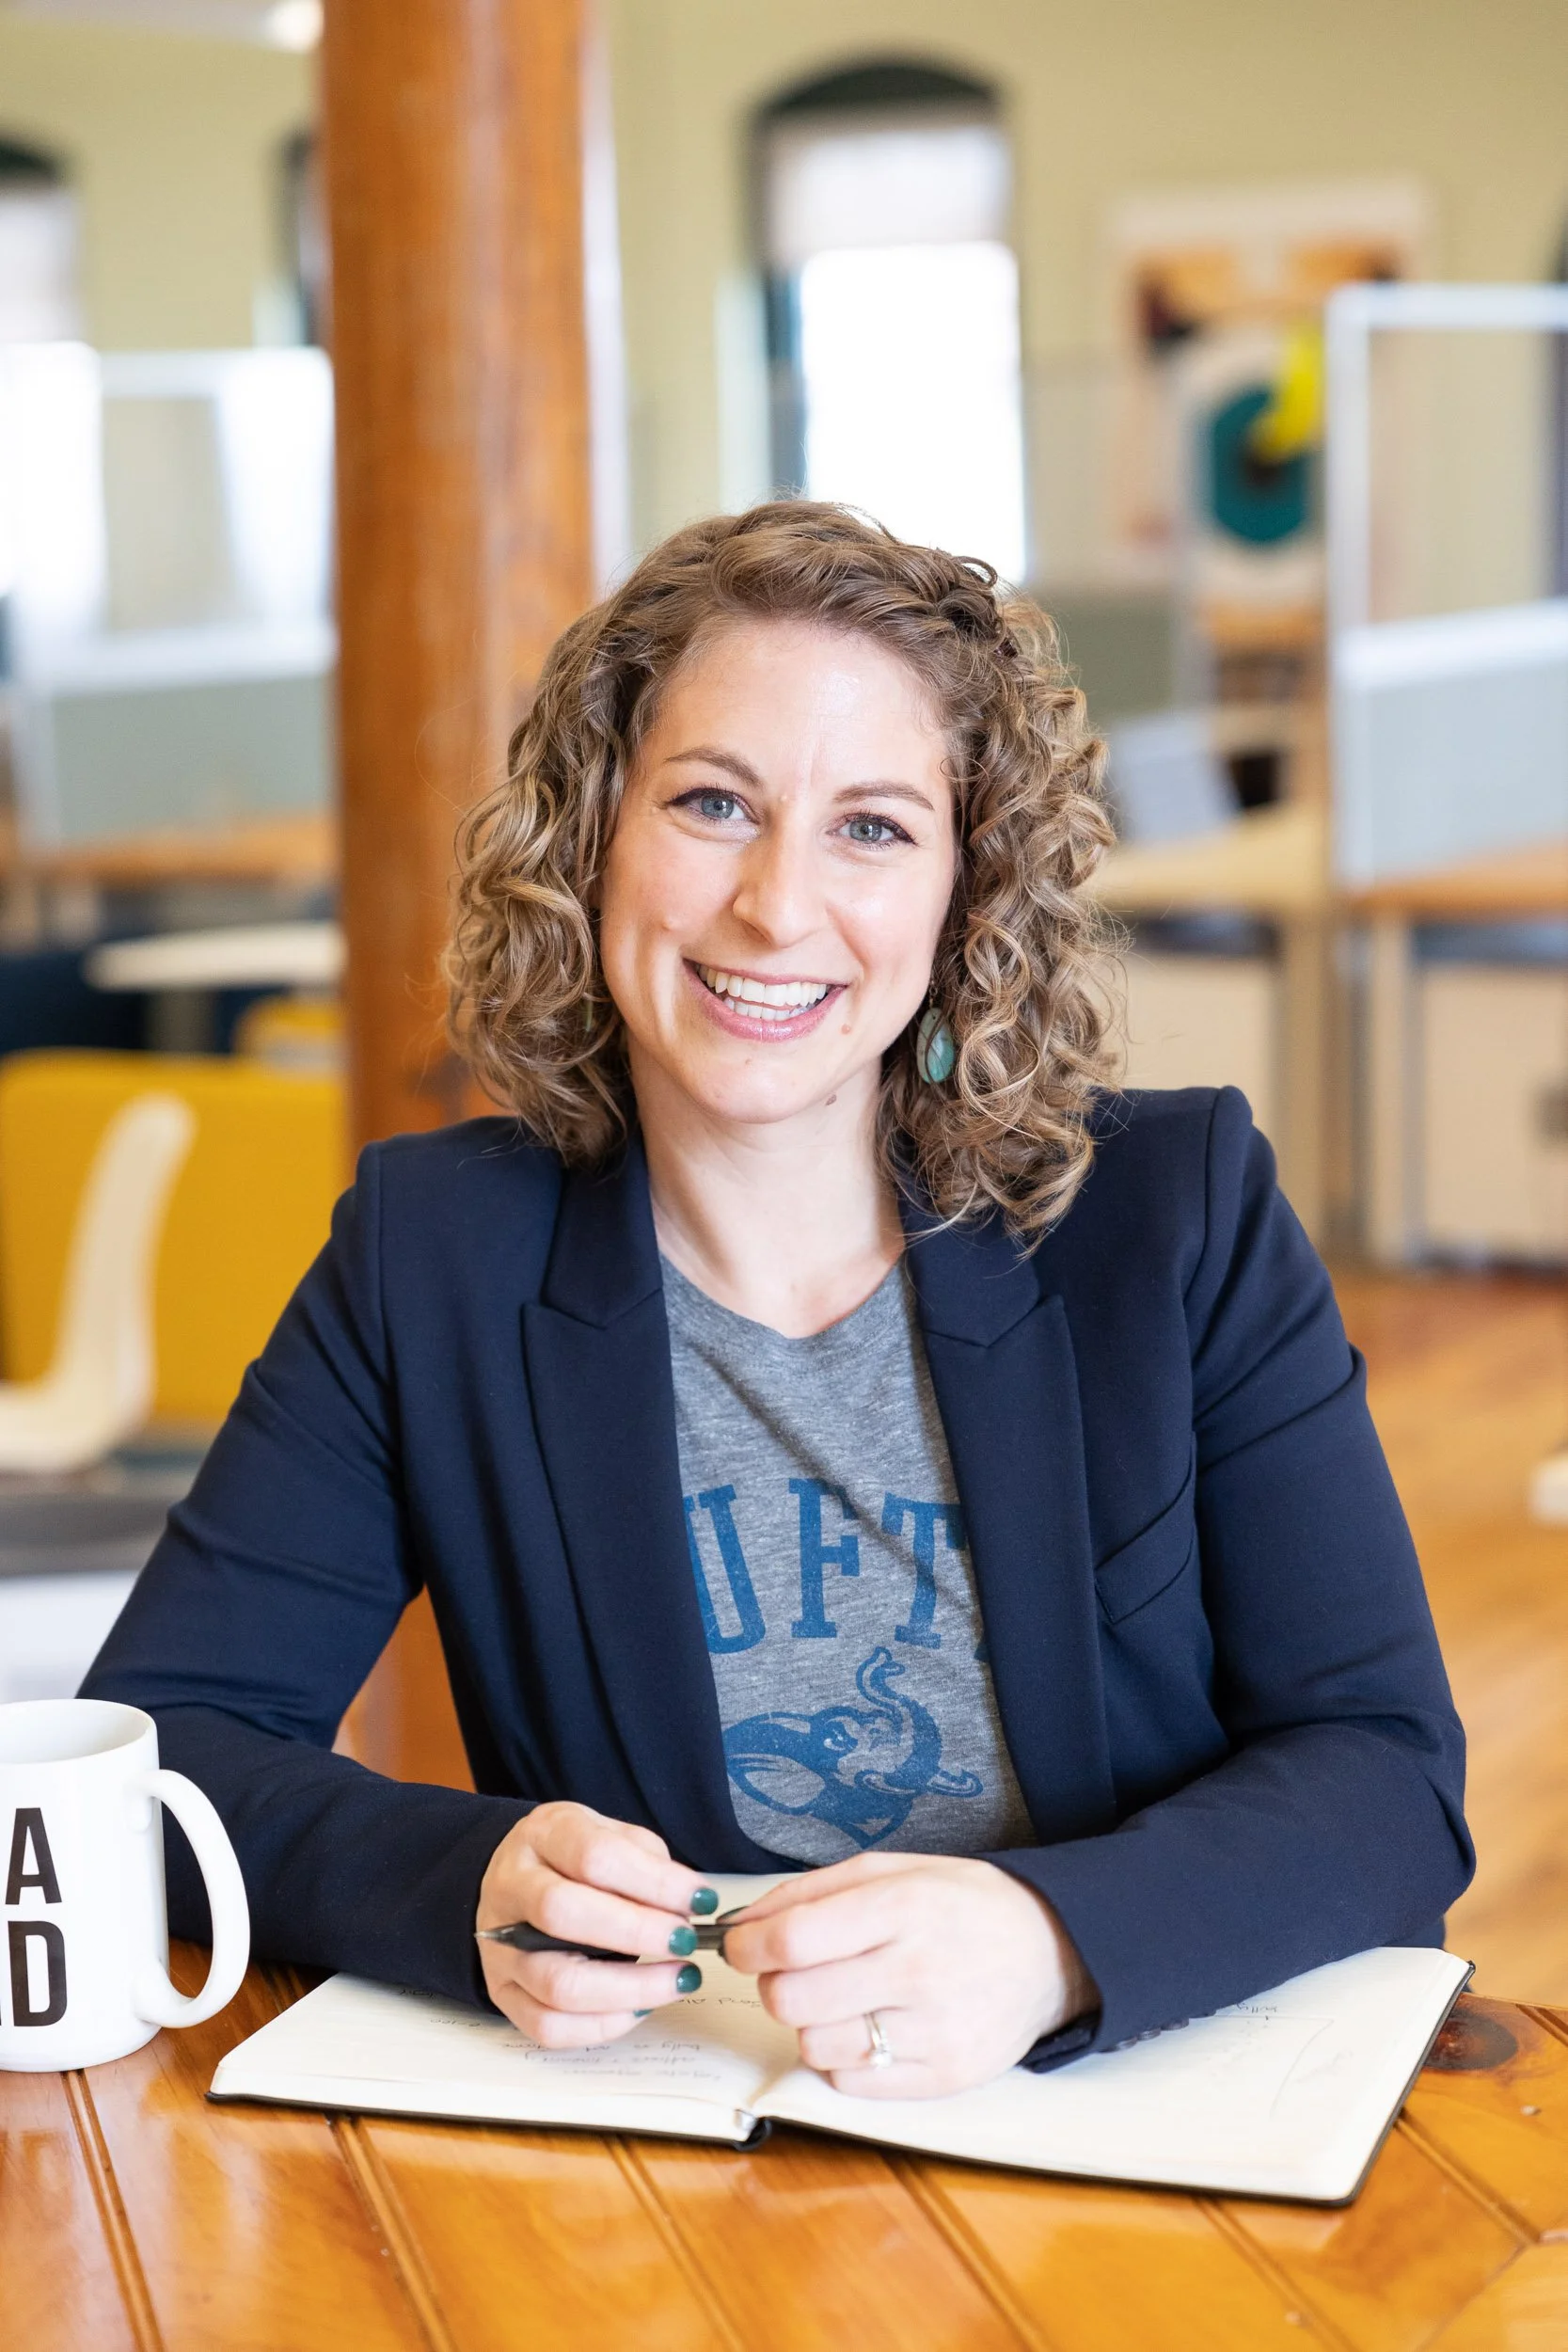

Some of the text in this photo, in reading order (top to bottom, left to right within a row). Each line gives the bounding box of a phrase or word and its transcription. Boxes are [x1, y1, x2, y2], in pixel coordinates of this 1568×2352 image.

[682, 1478, 987, 1662] UFT
[6, 1807, 62, 1905] A
[0, 1920, 68, 2027] D
